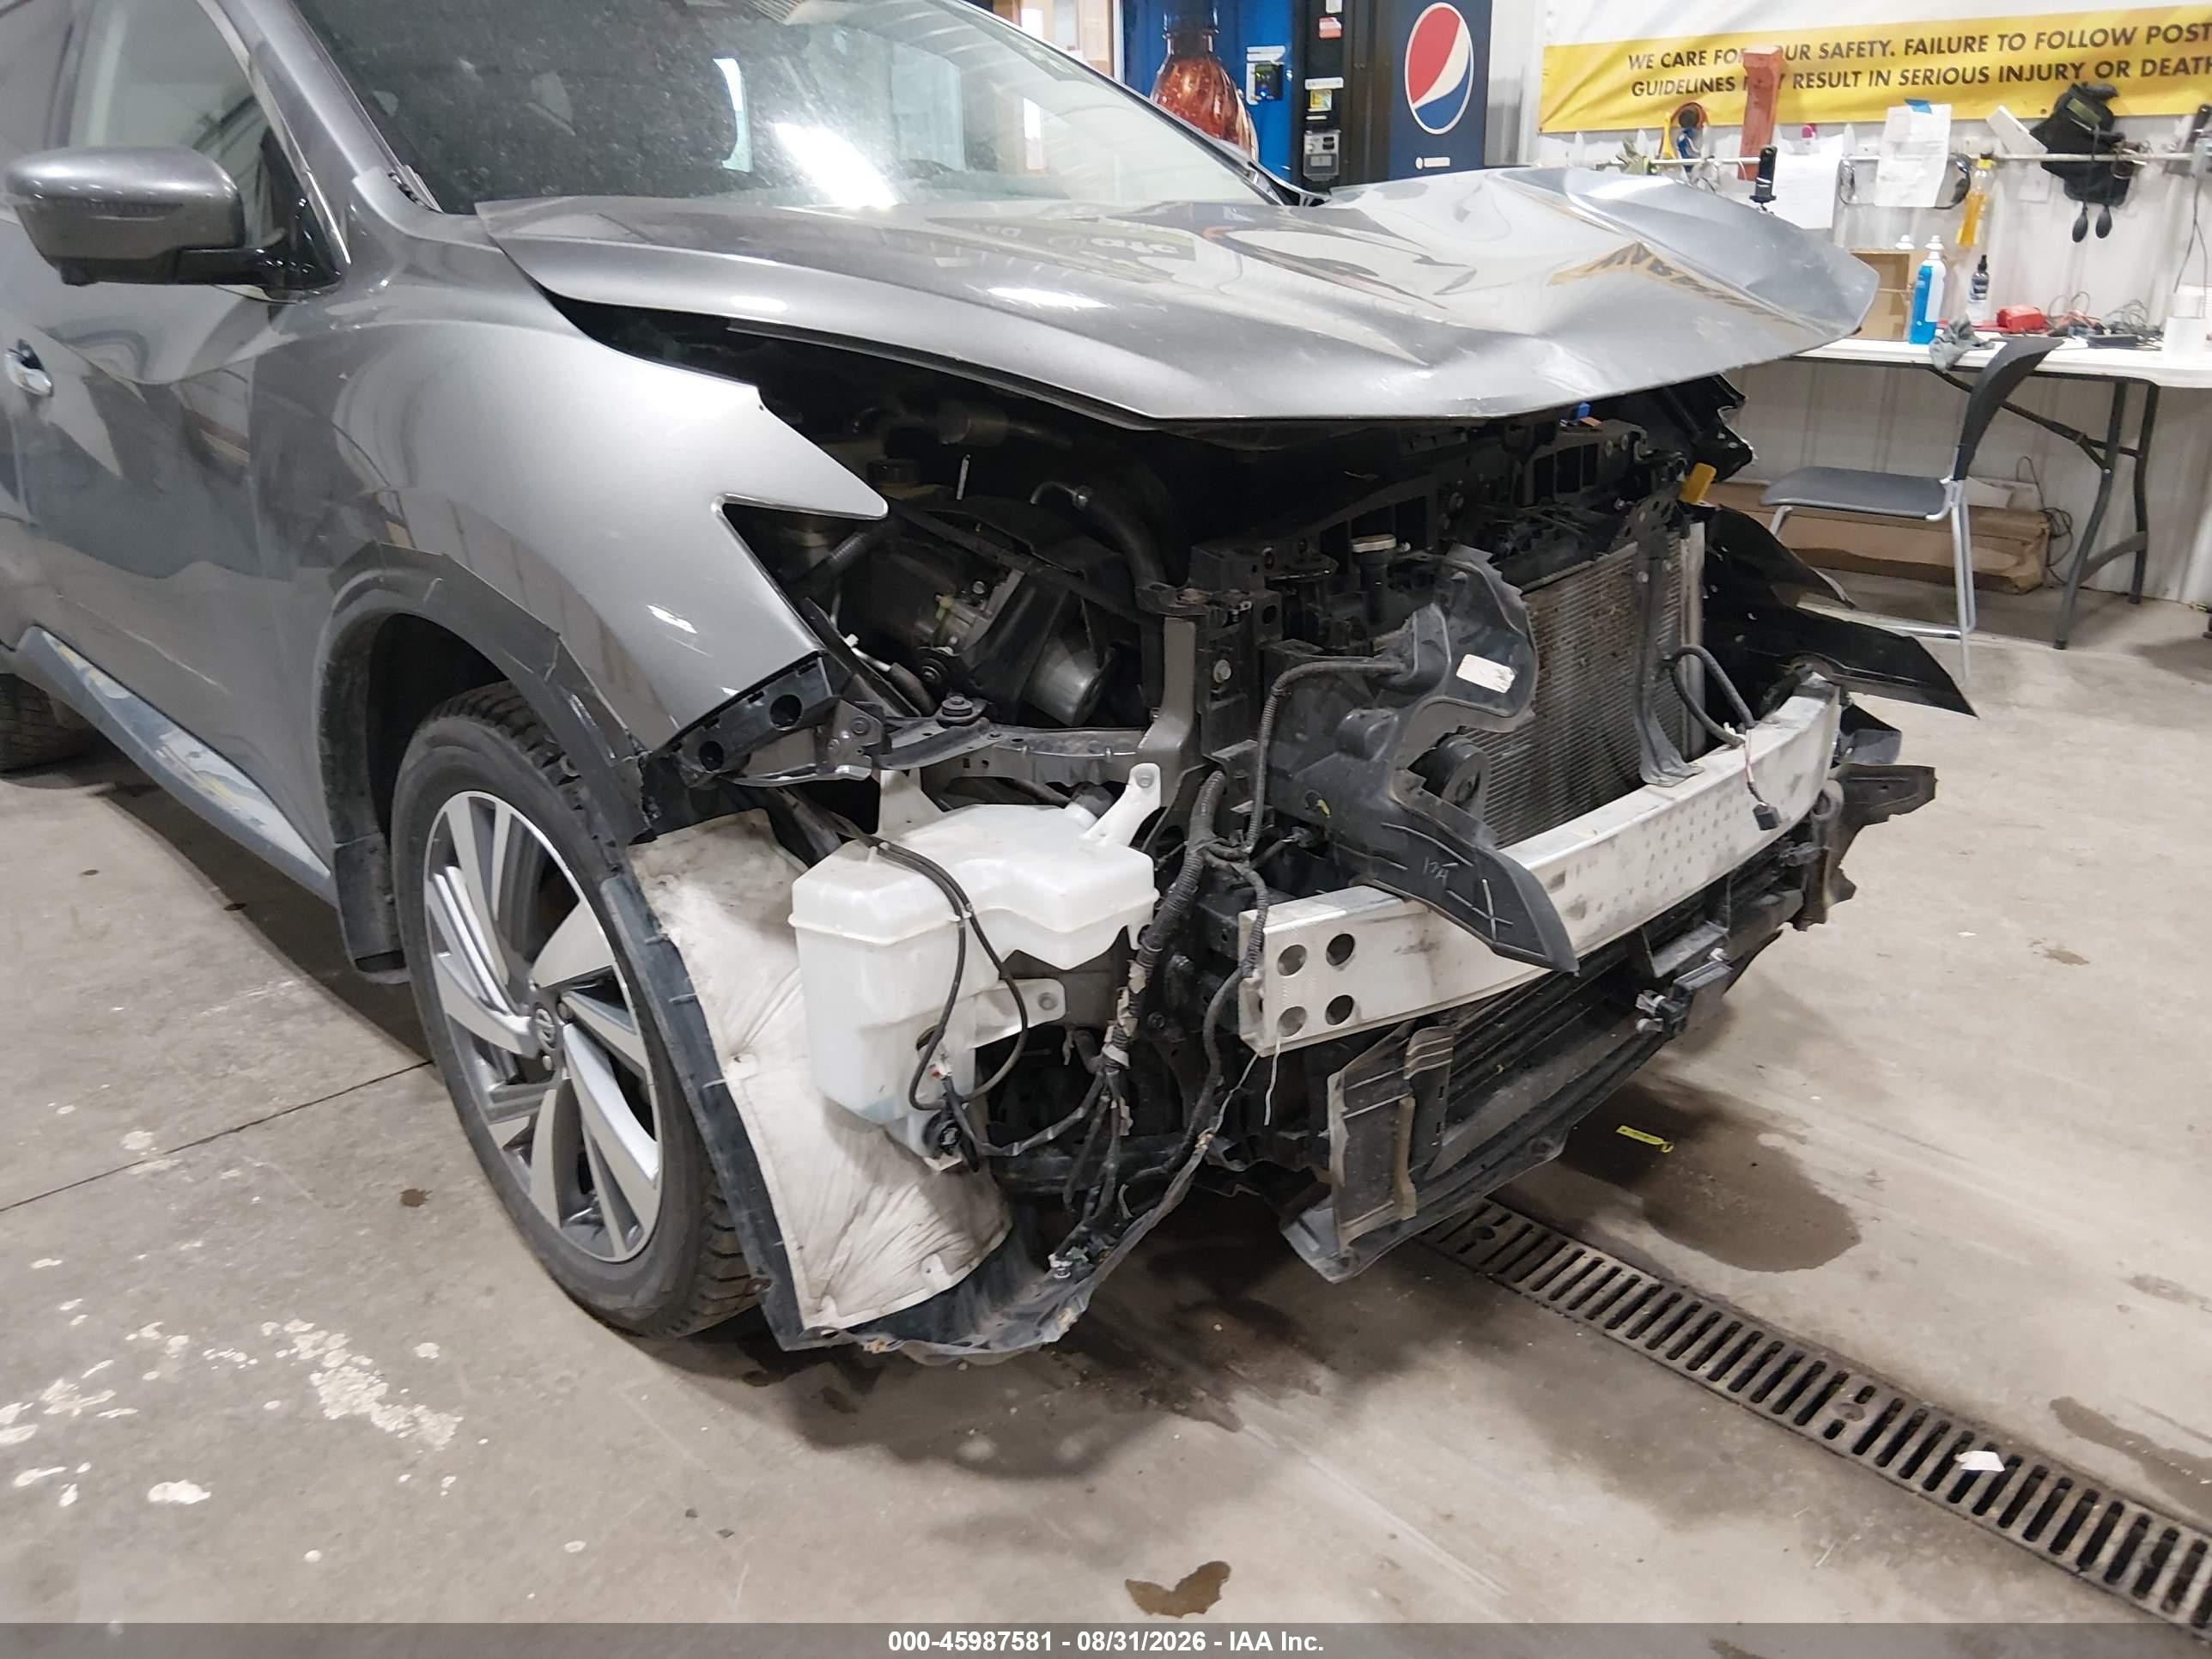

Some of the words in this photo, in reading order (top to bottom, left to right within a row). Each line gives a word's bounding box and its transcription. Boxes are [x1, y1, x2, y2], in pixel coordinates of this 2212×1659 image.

[1628, 53, 1655, 70] WE
[1661, 50, 1707, 69] CARE
[1818, 39, 1895, 59] SAFETY.
[1904, 34, 1989, 56] FAILURE
[1997, 33, 2027, 52] TO
[2034, 26, 2138, 50] FOLLOW
[2145, 22, 2212, 45] POST
[1632, 76, 1735, 97] GUIDELINES
[1792, 70, 1863, 89] RESULT
[1868, 69, 1891, 87] IN
[1898, 65, 1990, 86] SERIOUS
[1998, 62, 2086, 82] INJURY
[2094, 59, 2130, 79] OR
